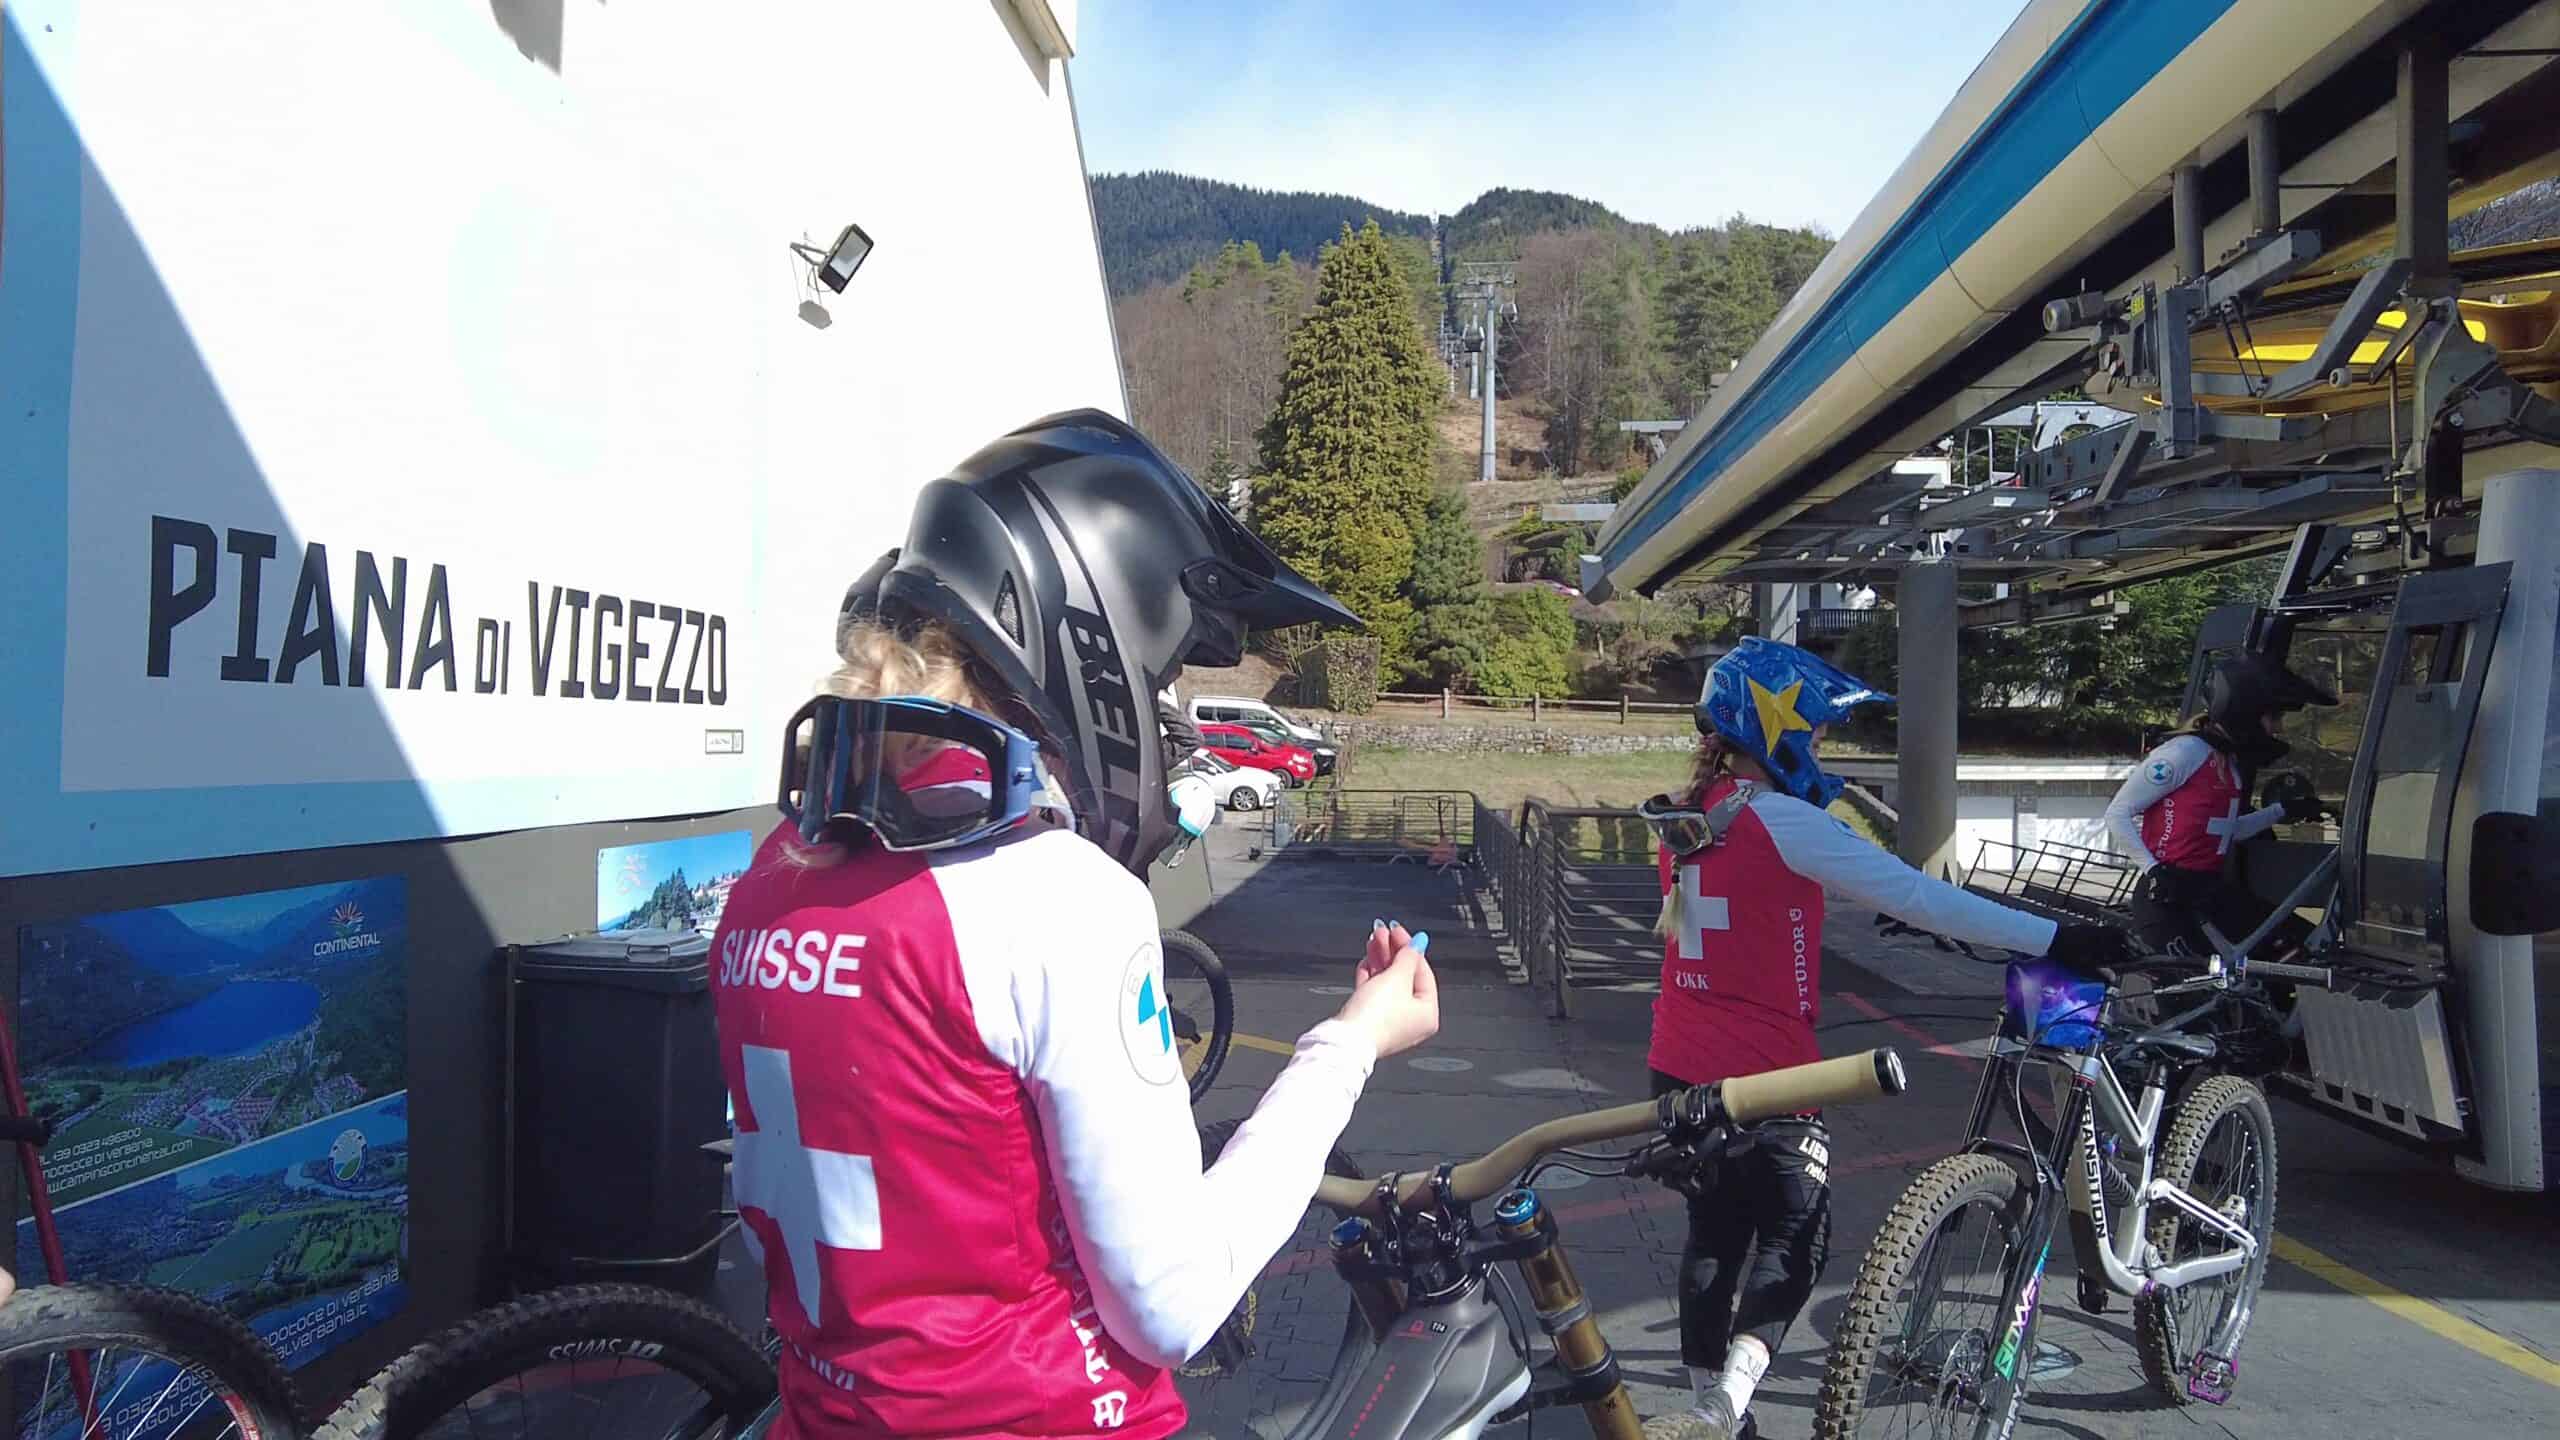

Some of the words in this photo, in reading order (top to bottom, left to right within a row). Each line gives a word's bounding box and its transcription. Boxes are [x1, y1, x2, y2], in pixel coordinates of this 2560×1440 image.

[146, 515, 457, 692] PIANA
[475, 617, 511, 694] DI
[527, 580, 727, 706] VIGEZZO
[313, 932, 381, 956] CONTINENTAL
[719, 927, 868, 998] SUISSE
[1793, 925, 1809, 996] TUDOR
